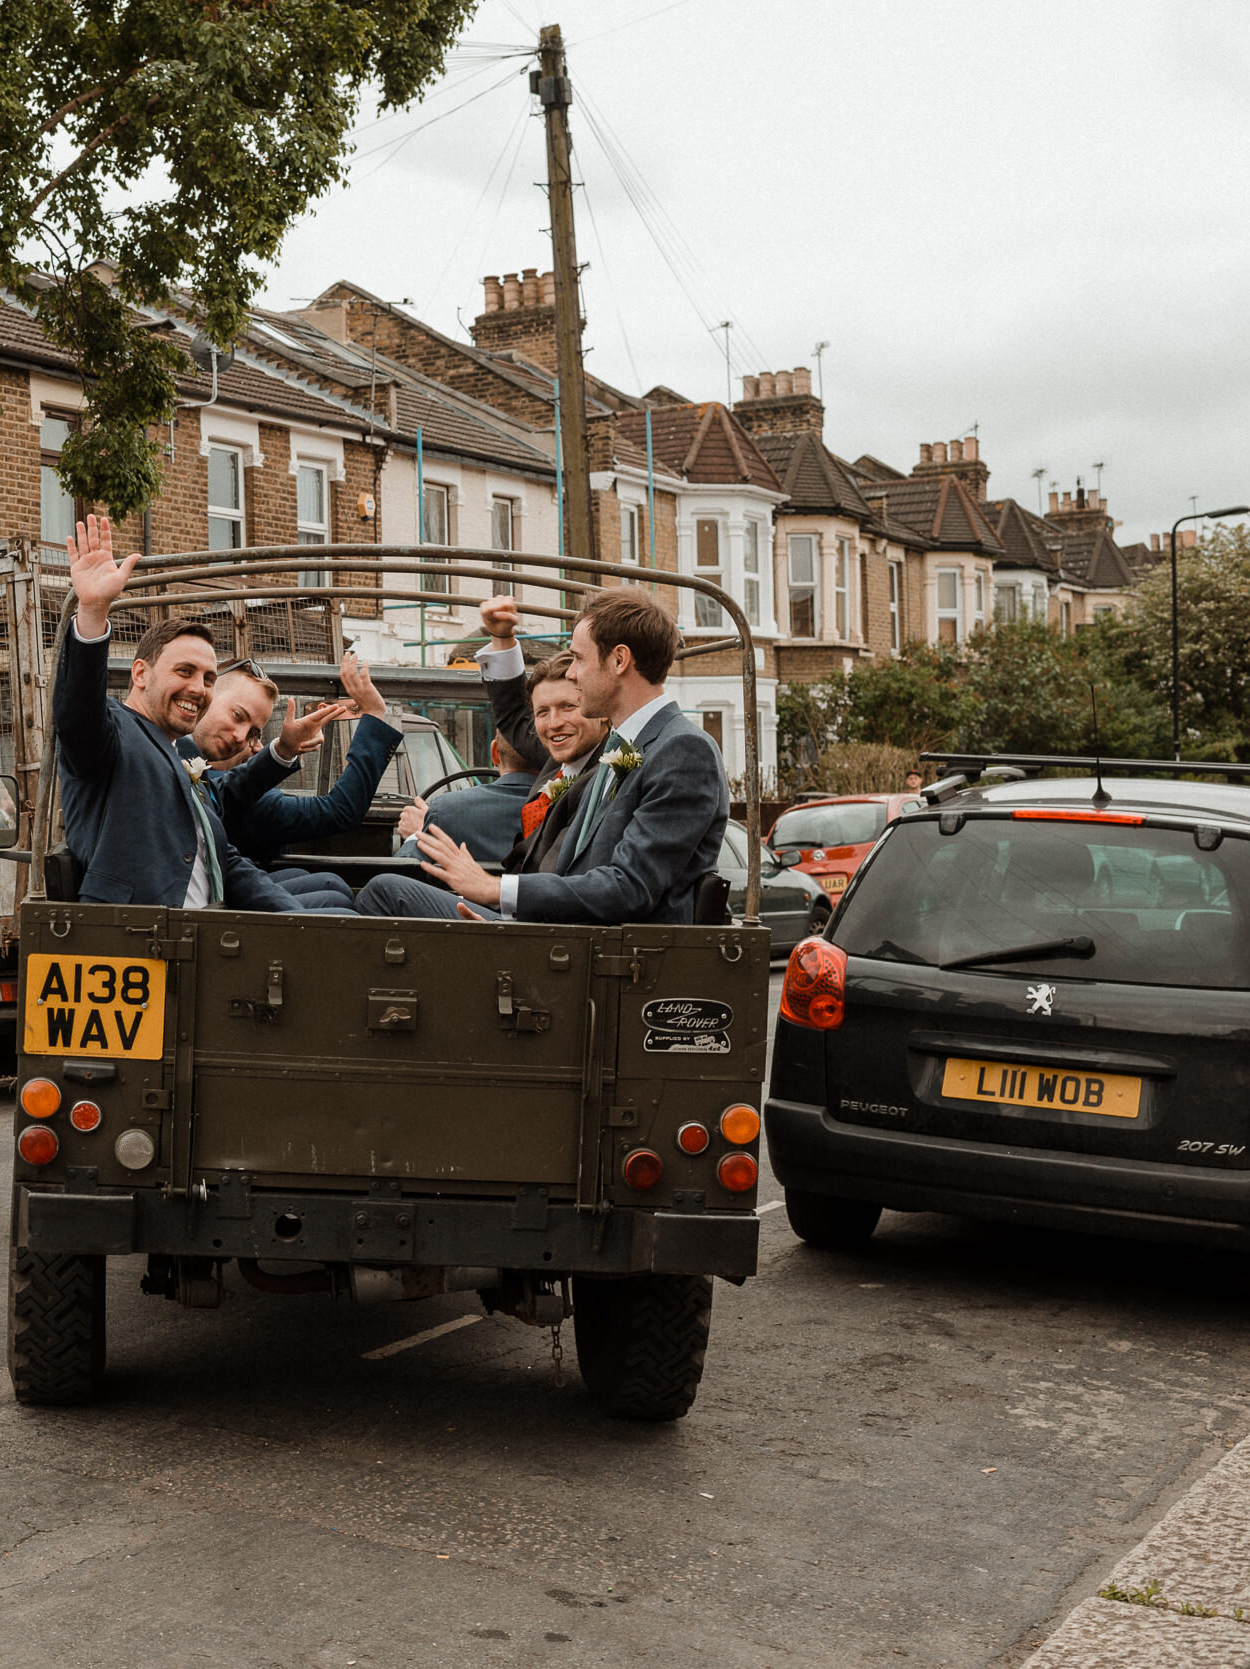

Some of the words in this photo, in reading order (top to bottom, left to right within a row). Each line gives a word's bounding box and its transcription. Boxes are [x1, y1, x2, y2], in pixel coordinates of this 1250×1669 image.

[40, 962, 149, 1005] A138
[657, 1003, 694, 1013] LAND
[47, 1007, 143, 1050] WAV
[676, 1017, 719, 1028] ROVER
[1037, 1073, 1104, 1107] WOB
[840, 1099, 909, 1116] PEUGEOT
[1177, 1140, 1215, 1152] 207
[1214, 1144, 1246, 1155] SW
